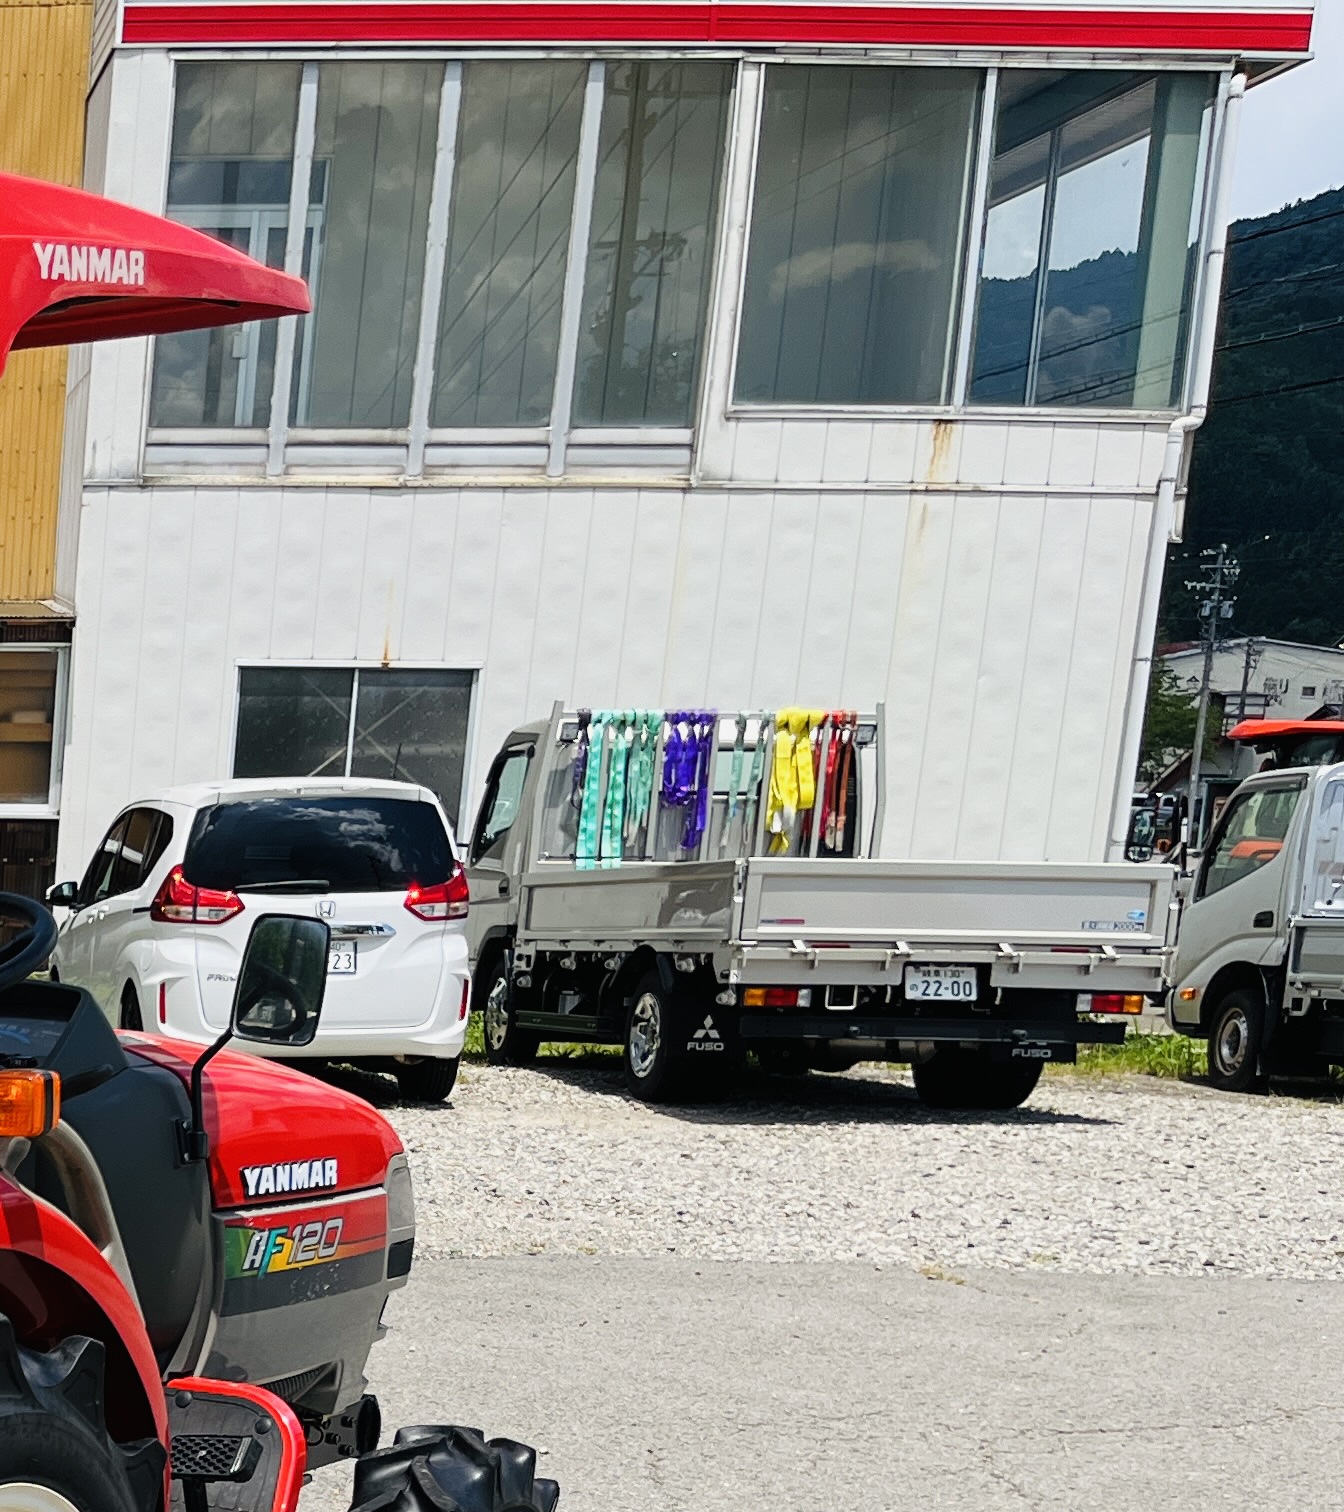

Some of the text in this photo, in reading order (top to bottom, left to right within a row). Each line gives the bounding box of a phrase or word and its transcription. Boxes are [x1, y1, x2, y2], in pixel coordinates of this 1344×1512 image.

[32, 242, 146, 286] YANMAR
[921, 980, 972, 997] 22-00
[687, 1041, 724, 1051] FUSO
[1012, 1048, 1052, 1058] FUSO
[242, 1158, 338, 1196] YANMAR
[242, 1218, 344, 1280] AF120
